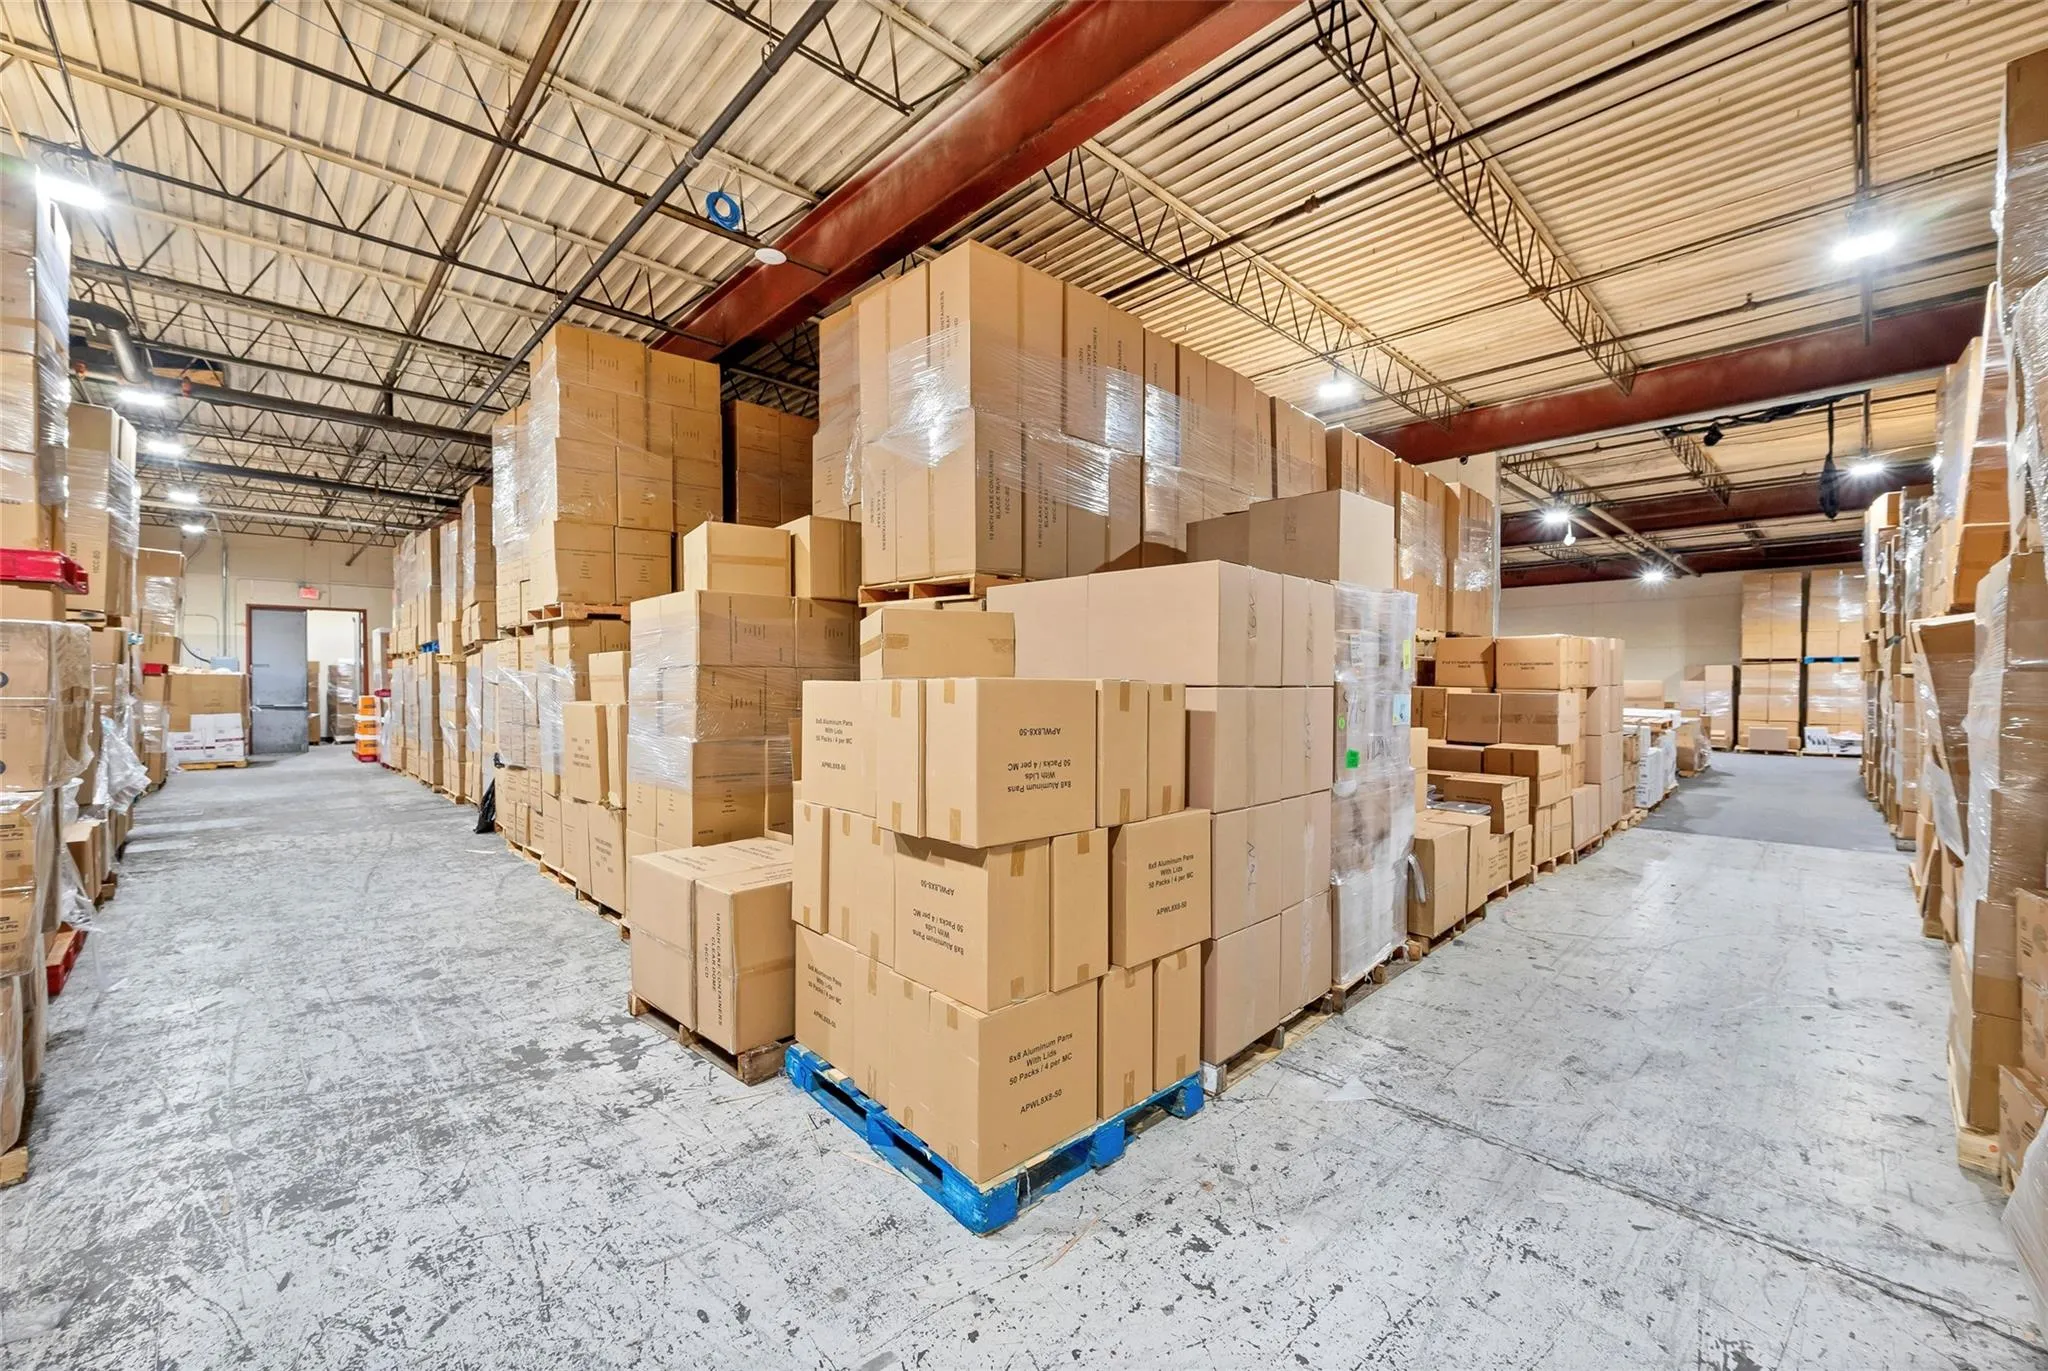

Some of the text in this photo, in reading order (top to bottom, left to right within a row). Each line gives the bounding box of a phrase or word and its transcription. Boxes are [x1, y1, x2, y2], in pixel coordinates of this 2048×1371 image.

[1008, 763, 1019, 771] MC
[1043, 760, 1062, 768] Packs
[1064, 759, 1071, 767] 50
[1024, 772, 1039, 780] Lids
[1026, 782, 1059, 790] Aluminum
[1158, 857, 1182, 867] Aluminum
[1155, 879, 1170, 887] Packs
[913, 908, 921, 918] MC
[939, 917, 956, 930] Packs
[957, 923, 964, 933] 50
[912, 929, 925, 940] Pans
[925, 923, 950, 939] With Lids
[926, 934, 953, 951] Aluminum
[1009, 1032, 1072, 1063] 8x8 Aluminum Pans
[1026, 1050, 1057, 1066] With Lids
[1009, 1076, 1018, 1086] 50
[1019, 1067, 1040, 1081] Packs
[1050, 1058, 1061, 1069] per
[1062, 1052, 1072, 1062] MC
[1020, 1088, 1062, 1115] APWL8X8-50
